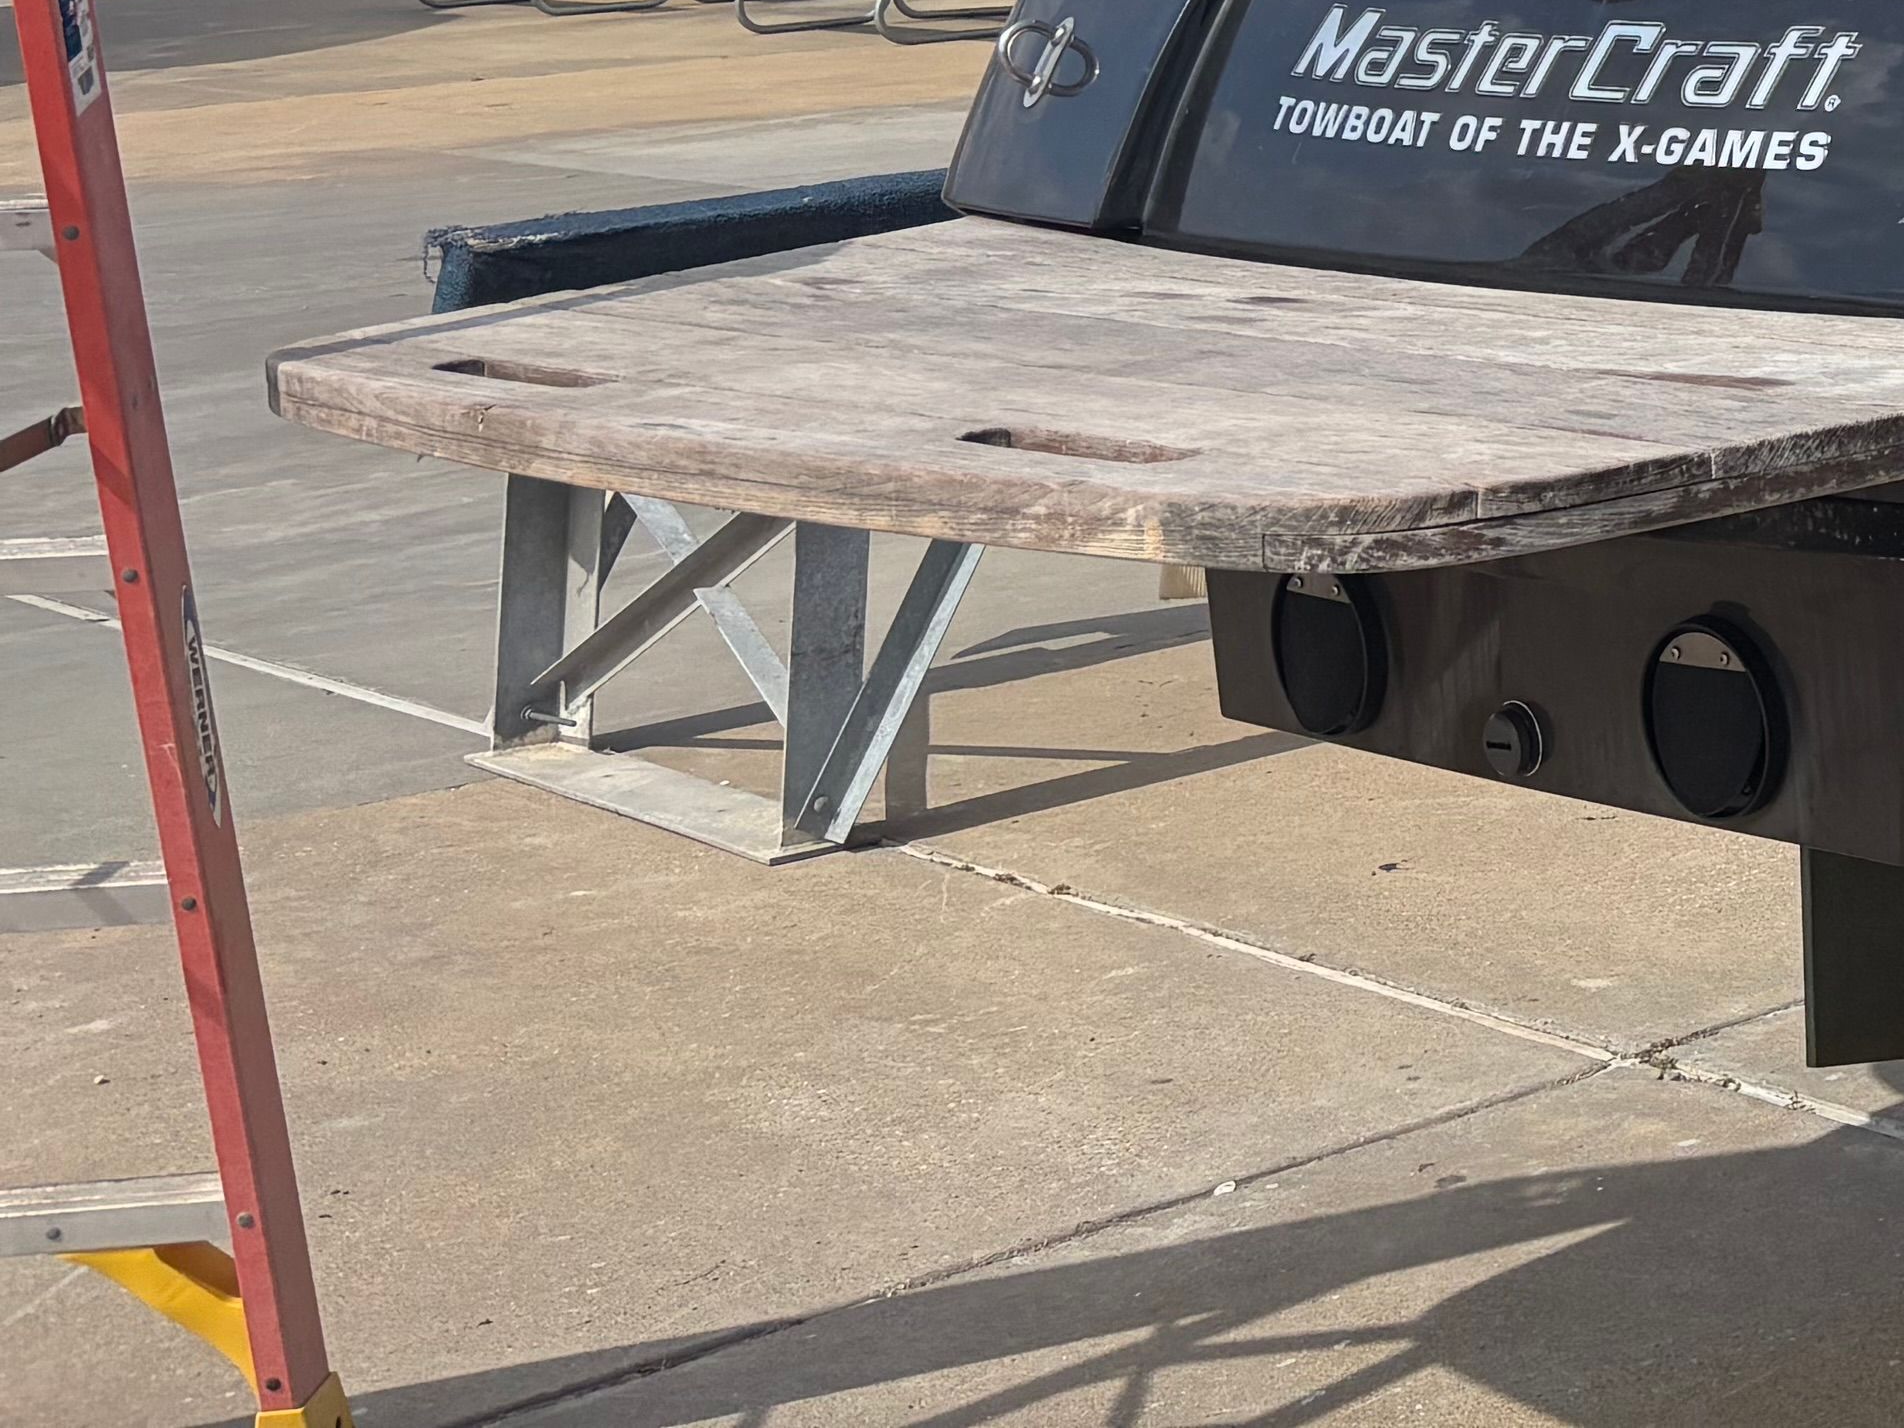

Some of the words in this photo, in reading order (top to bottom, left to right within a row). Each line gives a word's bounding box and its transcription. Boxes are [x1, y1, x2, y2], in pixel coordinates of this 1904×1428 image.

[1273, 96, 1440, 149] TOWBOAT
[1449, 116, 1503, 152] OF
[1517, 119, 1599, 161] THE
[1608, 125, 1831, 171] X-GAMES
[188, 635, 215, 777] WERNER
